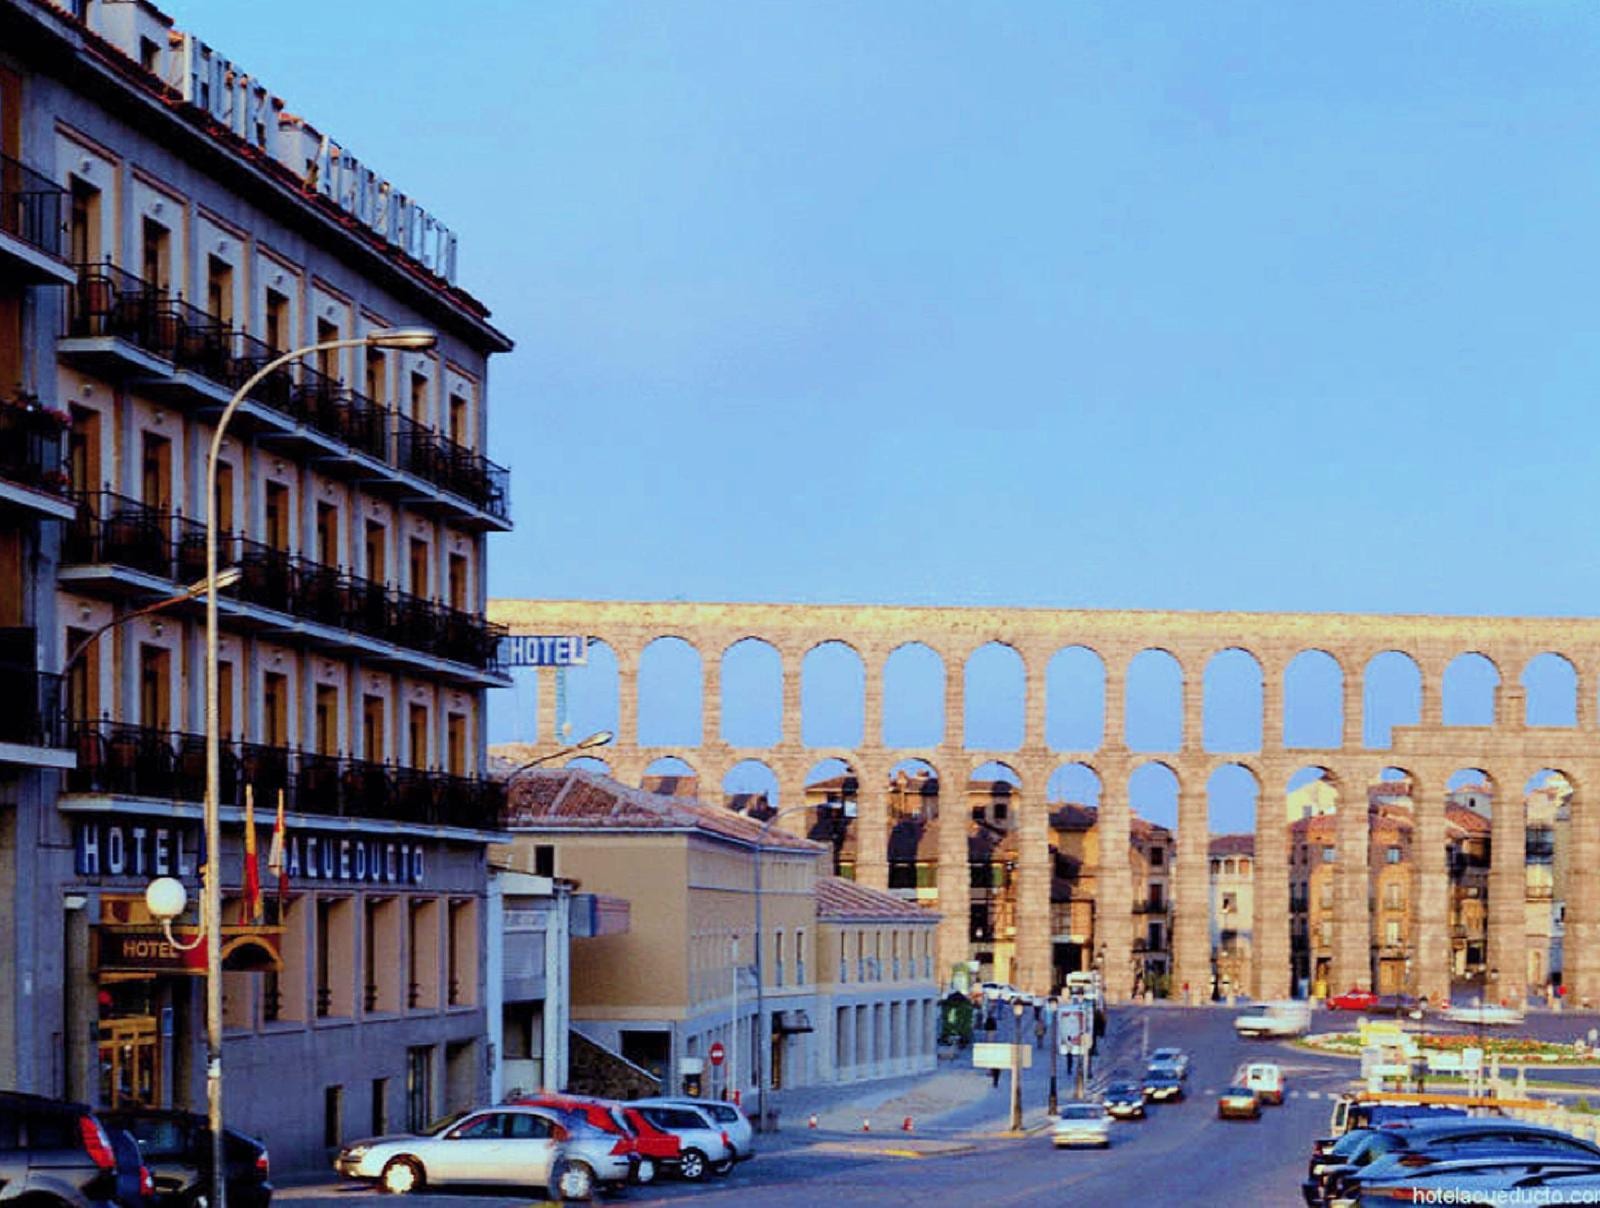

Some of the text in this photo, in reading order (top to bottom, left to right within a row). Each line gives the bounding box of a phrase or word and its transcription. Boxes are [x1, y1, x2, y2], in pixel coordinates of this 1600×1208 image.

[509, 636, 587, 665] HOTEL
[83, 825, 424, 882] HOTEL ACUEDUCTO
[123, 941, 180, 958] HOTEL
